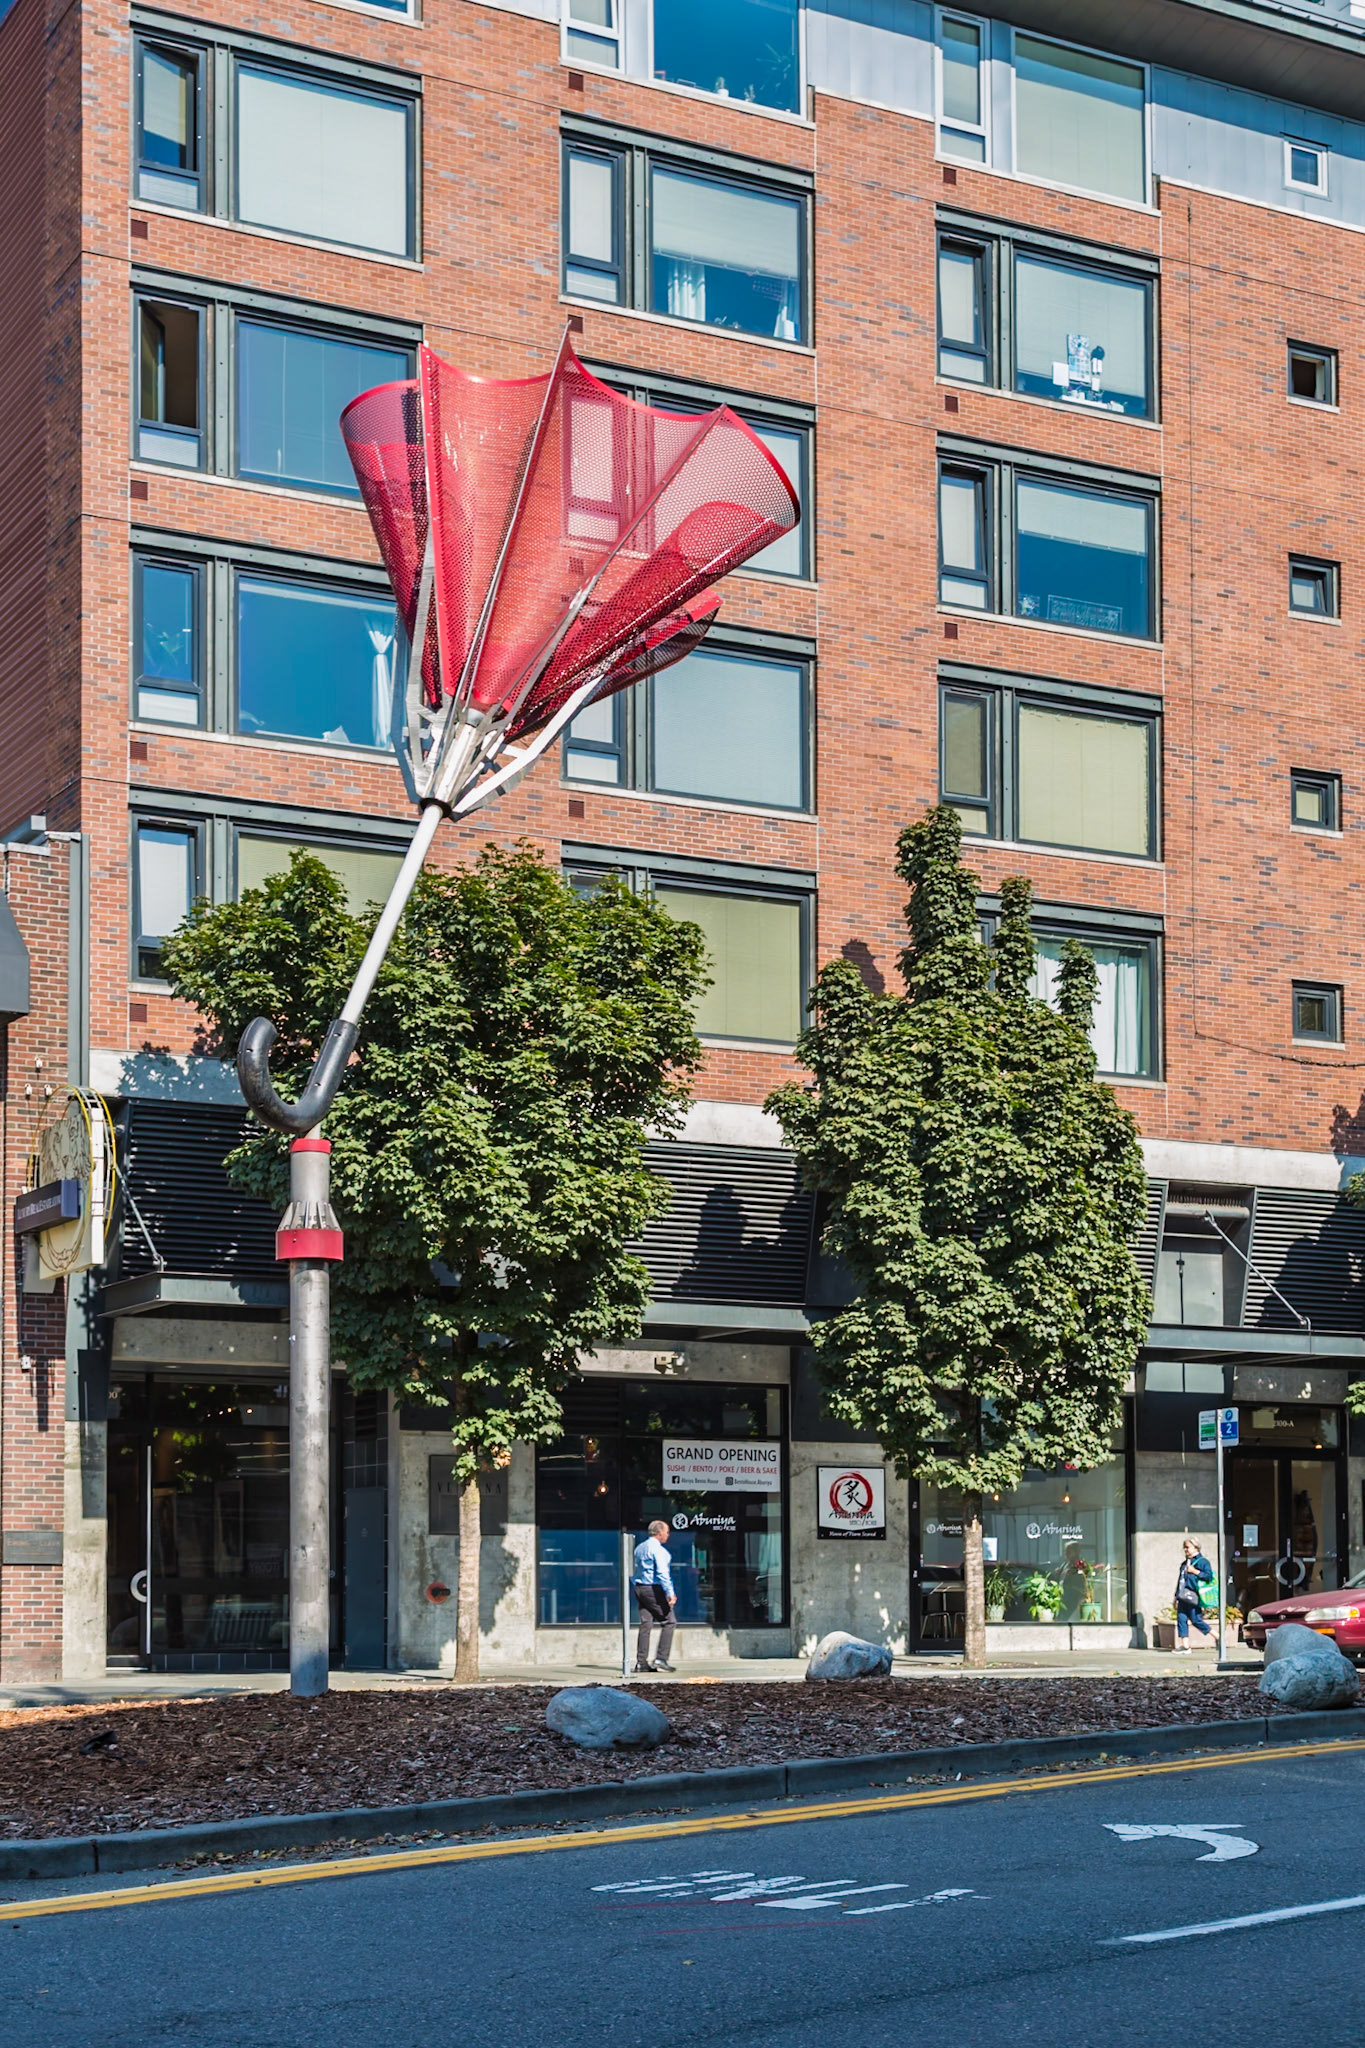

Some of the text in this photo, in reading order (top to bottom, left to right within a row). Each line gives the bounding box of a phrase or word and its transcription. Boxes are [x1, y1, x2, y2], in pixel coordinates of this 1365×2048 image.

[1226, 1423, 1232, 1433] 2
[666, 1447, 777, 1462] GRAND OPENING
[666, 1464, 686, 1472] SUSHI
[692, 1465, 713, 1473] BENTO
[740, 1466, 755, 1474] BEER
[762, 1467, 777, 1475] SAKE
[690, 1512, 736, 1529] Aburiya
[828, 1508, 875, 1526] Aburiya
[1042, 1522, 1082, 1535] Aburiya
